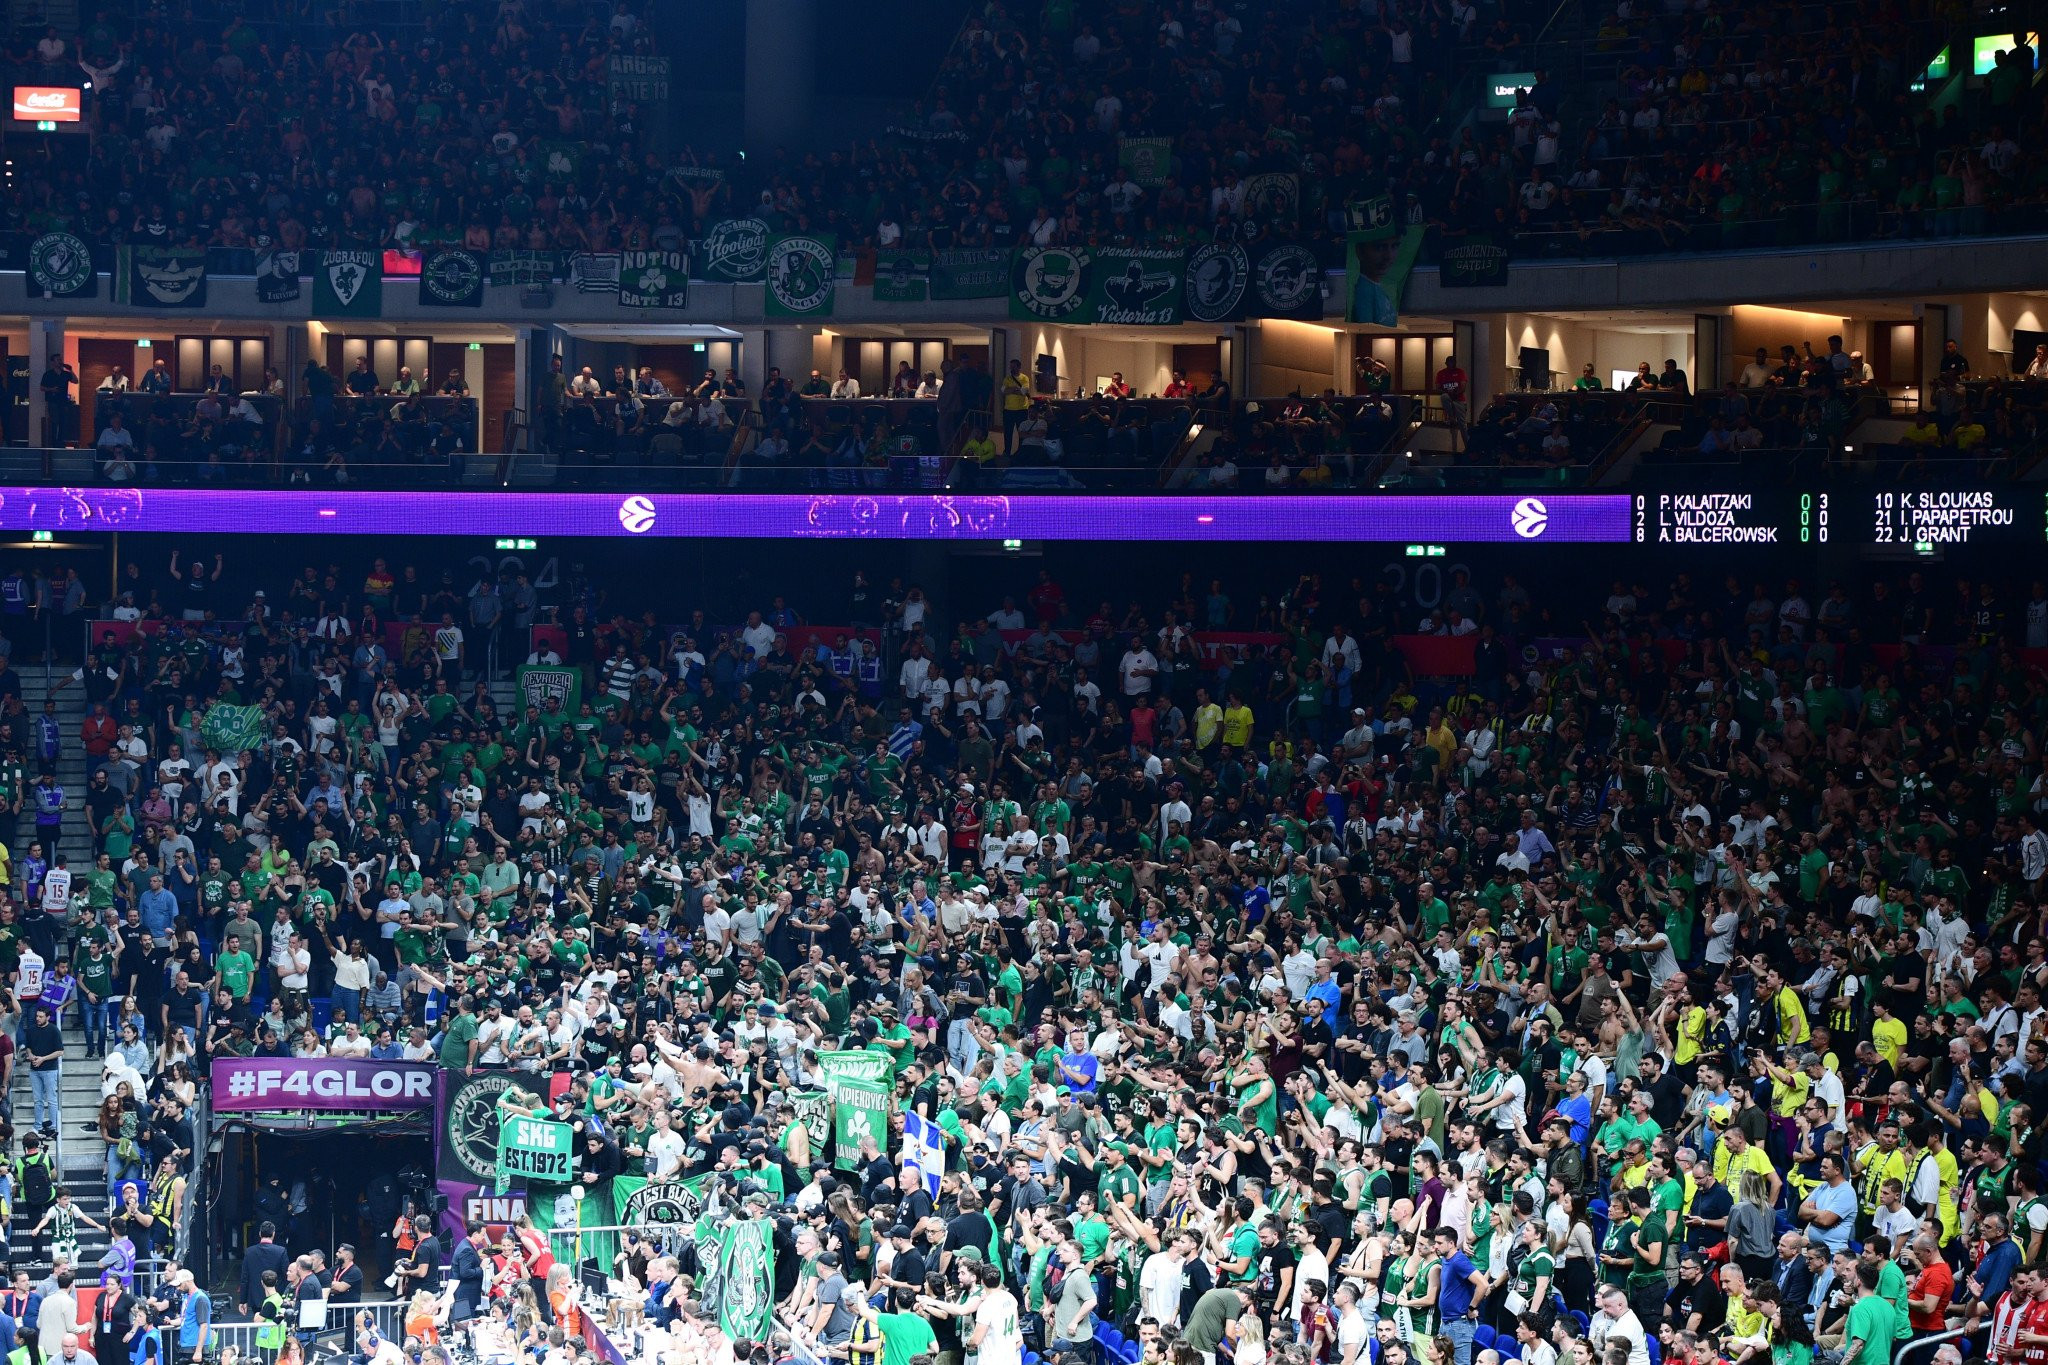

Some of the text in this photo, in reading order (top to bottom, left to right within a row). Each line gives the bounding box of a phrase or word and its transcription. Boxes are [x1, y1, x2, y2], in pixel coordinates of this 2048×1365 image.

[1495, 86, 1516, 96] Uber
[323, 251, 375, 267] ZOGRAFOU
[621, 290, 684, 306] GATE 13
[1018, 290, 1083, 317] GATE 13
[1097, 304, 1174, 323] Victoria 13
[1636, 493, 1828, 510] 0 P. KALAITZAKI 0 3
[1875, 492, 1993, 509] 10 K. SLOUKAS
[1636, 510, 1828, 526] 2 L. VILDOZA 0 0
[1875, 509, 2014, 526] 21 I. PAPAPETROU
[1636, 526, 1828, 542] 8 A. BALCEROWSK 0 0
[1875, 526, 1971, 542] 22 J. GRANT
[1977, 610, 1990, 625] 12
[52, 884, 64, 899] 15
[28, 970, 38, 985] 15
[229, 1068, 433, 1098] #F4GLOR
[517, 1120, 557, 1149] SKG
[504, 1146, 567, 1174] EST.1972
[630, 1186, 665, 1213] WEST
